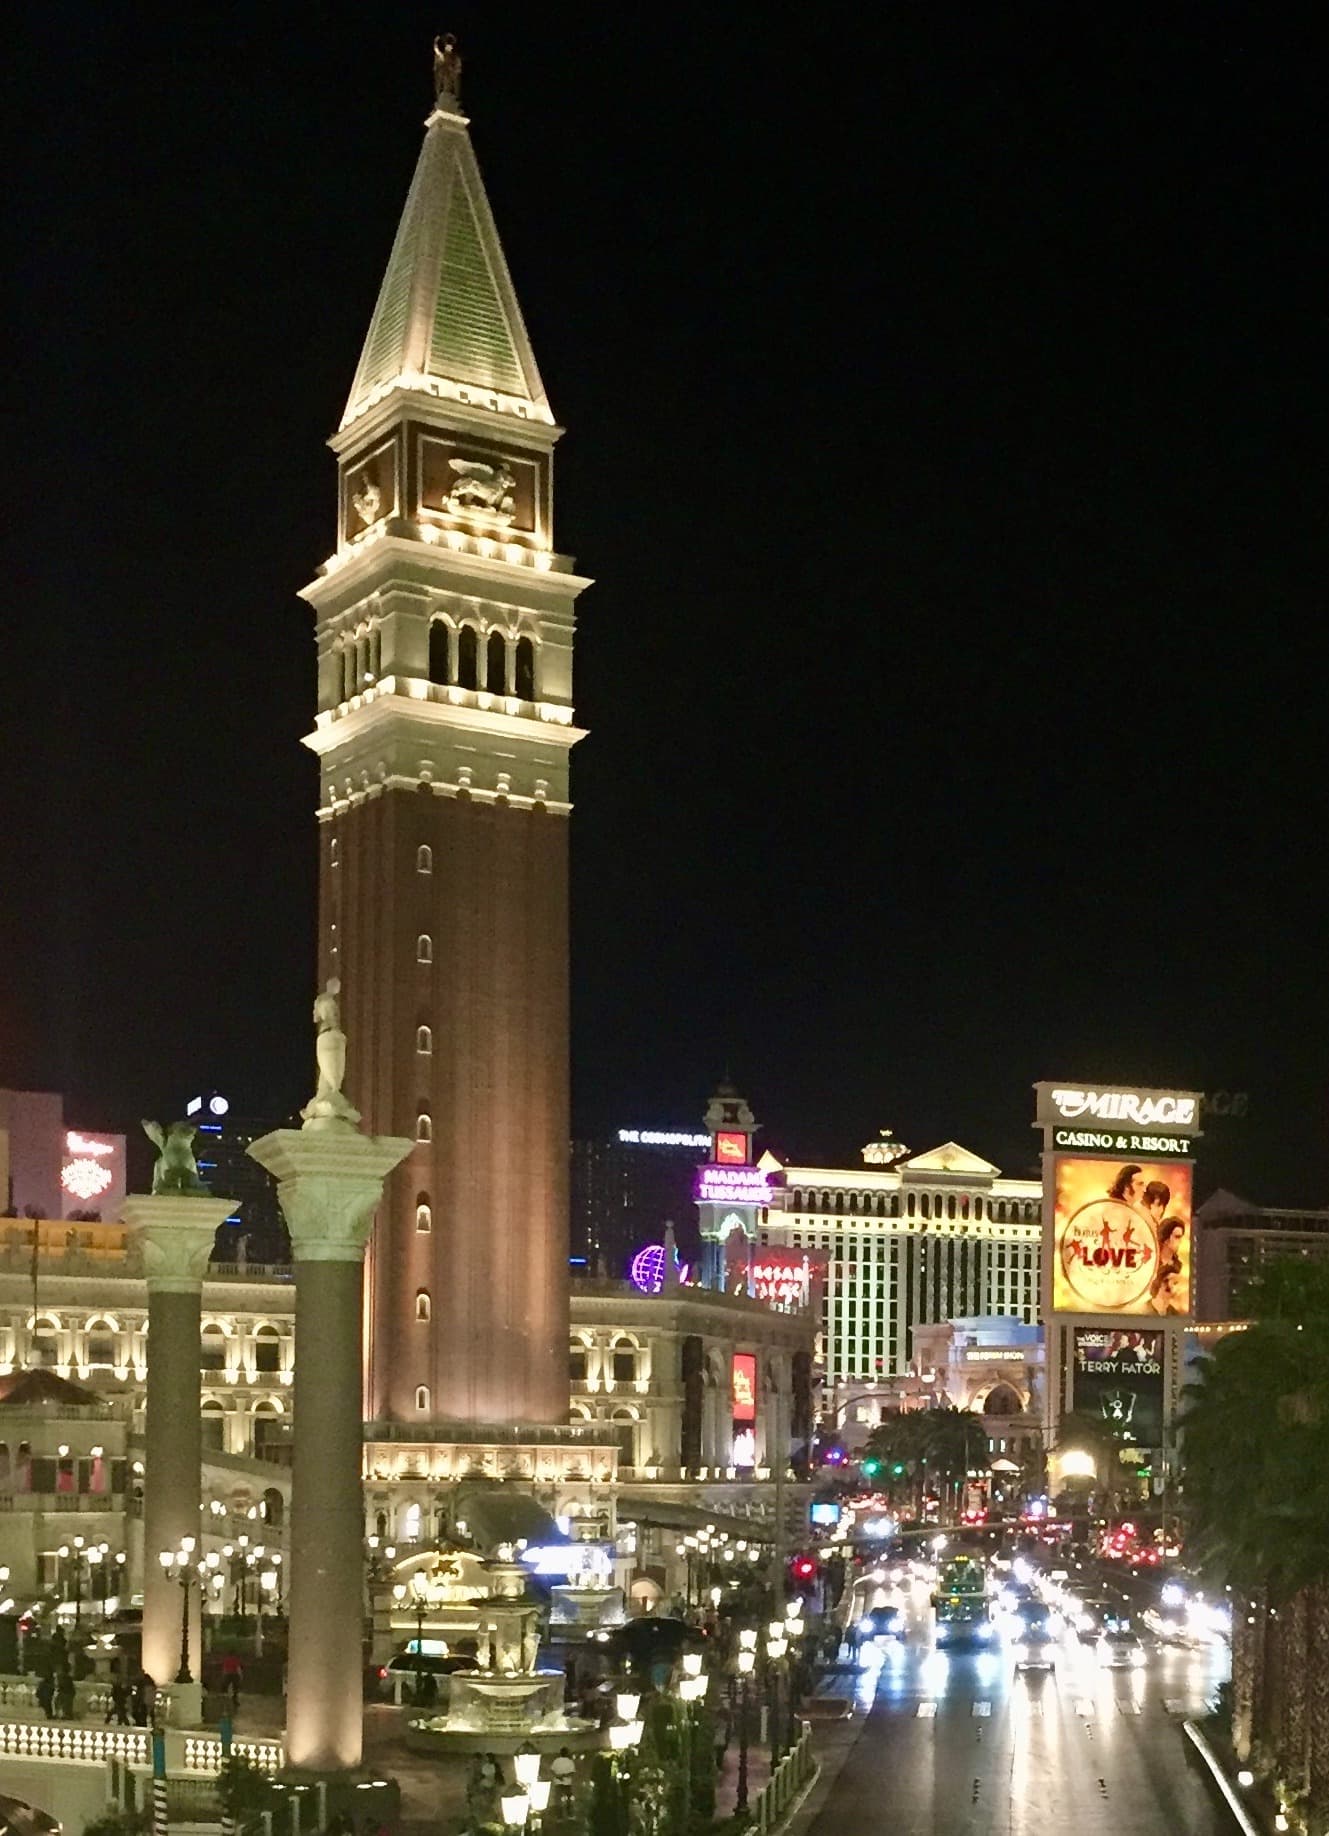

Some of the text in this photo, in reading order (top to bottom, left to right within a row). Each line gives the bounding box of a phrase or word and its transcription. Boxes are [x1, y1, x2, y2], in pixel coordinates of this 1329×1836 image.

[1060, 1091, 1195, 1124] MIRAGE
[618, 1129, 639, 1142] THE
[1056, 1131, 1190, 1153] CASINO & RESORT
[704, 1170, 768, 1186] MADAME
[1082, 1246, 1137, 1268] LOVE
[1079, 1361, 1160, 1375] TERRY FATOR
